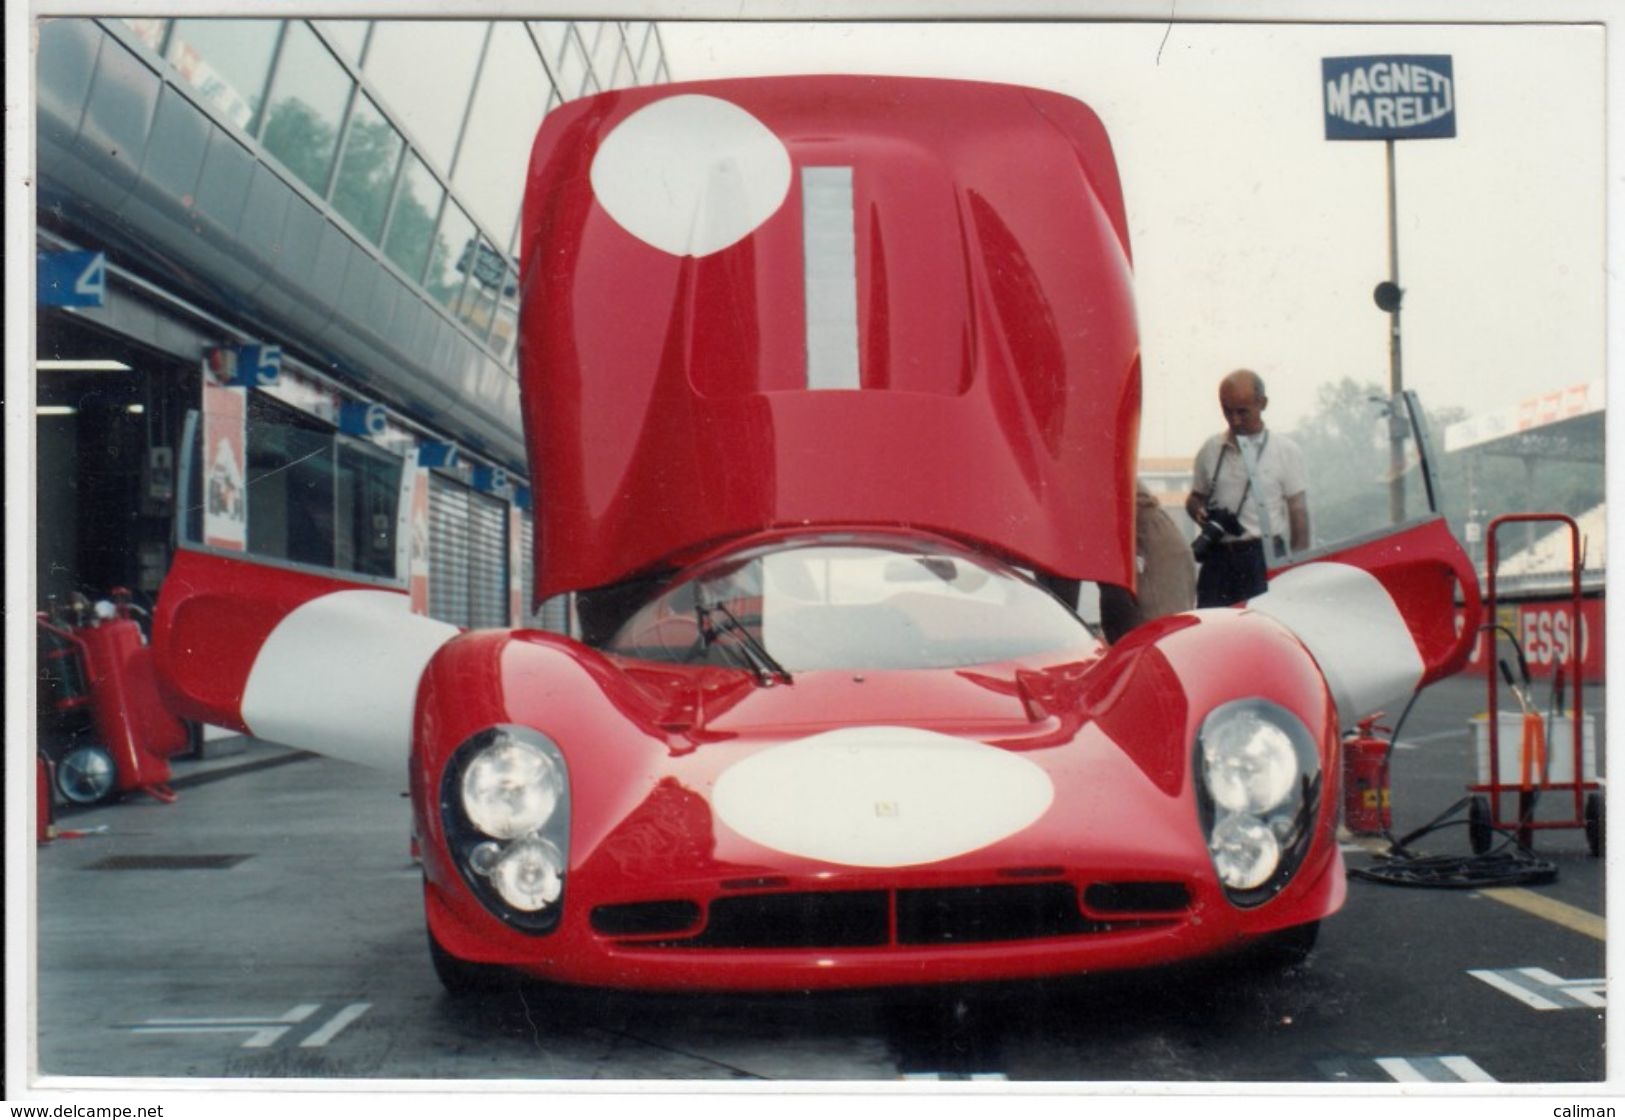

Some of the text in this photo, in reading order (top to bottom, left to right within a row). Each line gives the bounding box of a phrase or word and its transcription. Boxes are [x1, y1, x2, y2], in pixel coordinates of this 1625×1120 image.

[1326, 62, 1451, 97] MAGNETI
[1326, 95, 1451, 128] MARELLI
[75, 251, 105, 305] 4
[256, 345, 281, 386] 5
[365, 403, 388, 437] 6
[441, 440, 458, 467] 7
[492, 466, 507, 490] 8
